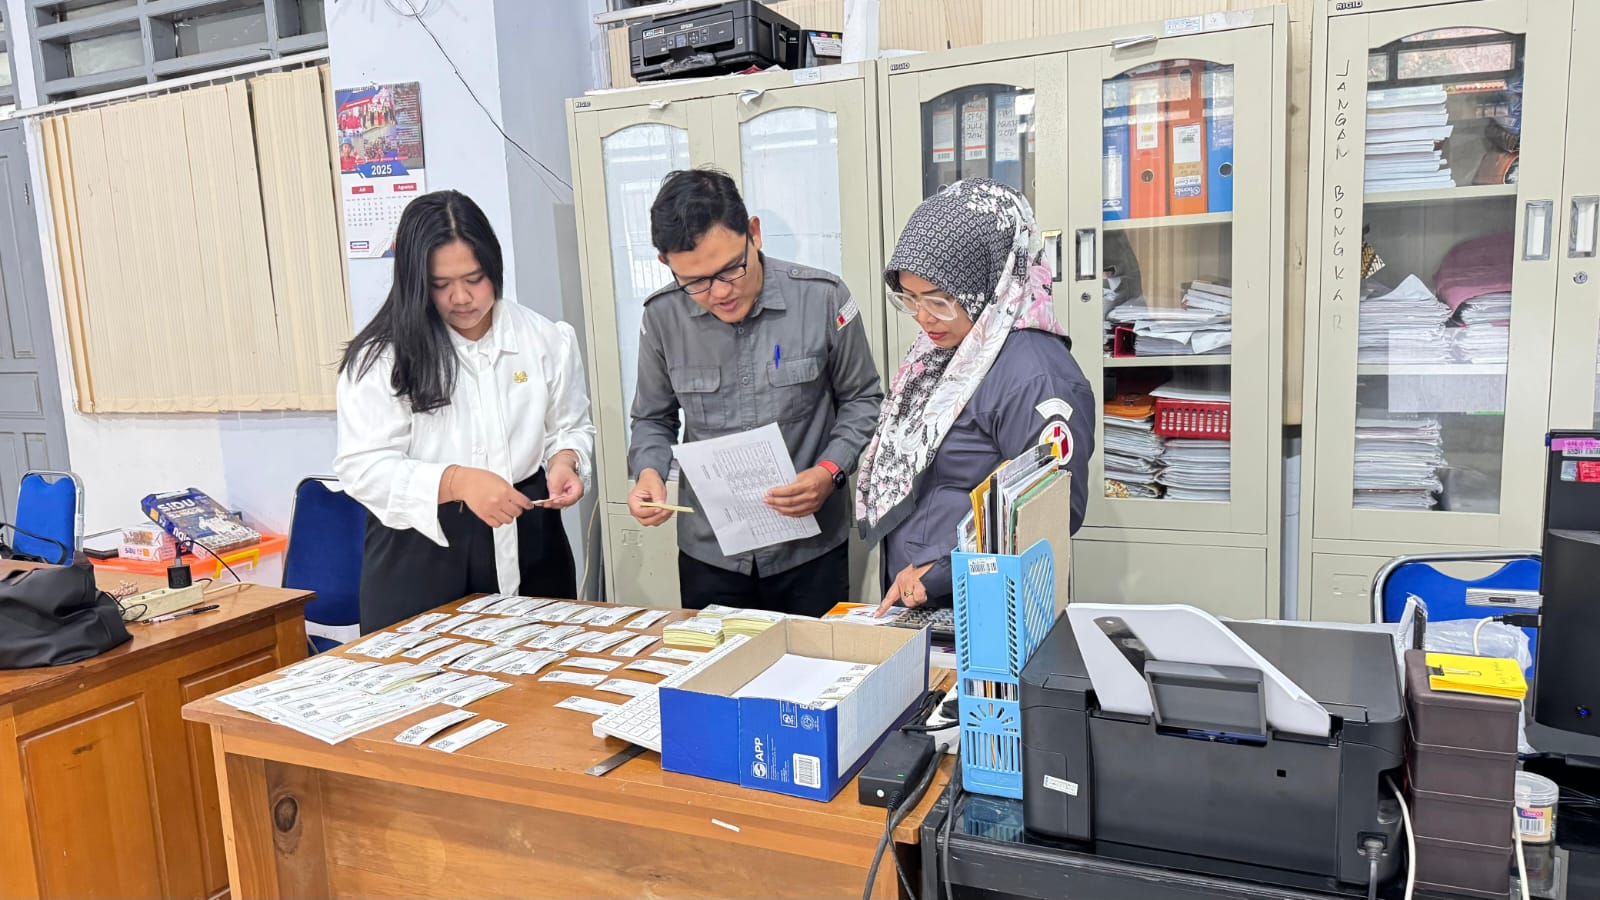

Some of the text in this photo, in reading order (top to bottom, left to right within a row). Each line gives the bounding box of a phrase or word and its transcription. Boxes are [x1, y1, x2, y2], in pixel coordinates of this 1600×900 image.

[1336, 1, 1363, 10] RIGID
[1335, 59, 1350, 161] JANGAN
[371, 164, 393, 176] 2025
[157, 498, 196, 512] SIDU
[754, 737, 764, 762] APP
